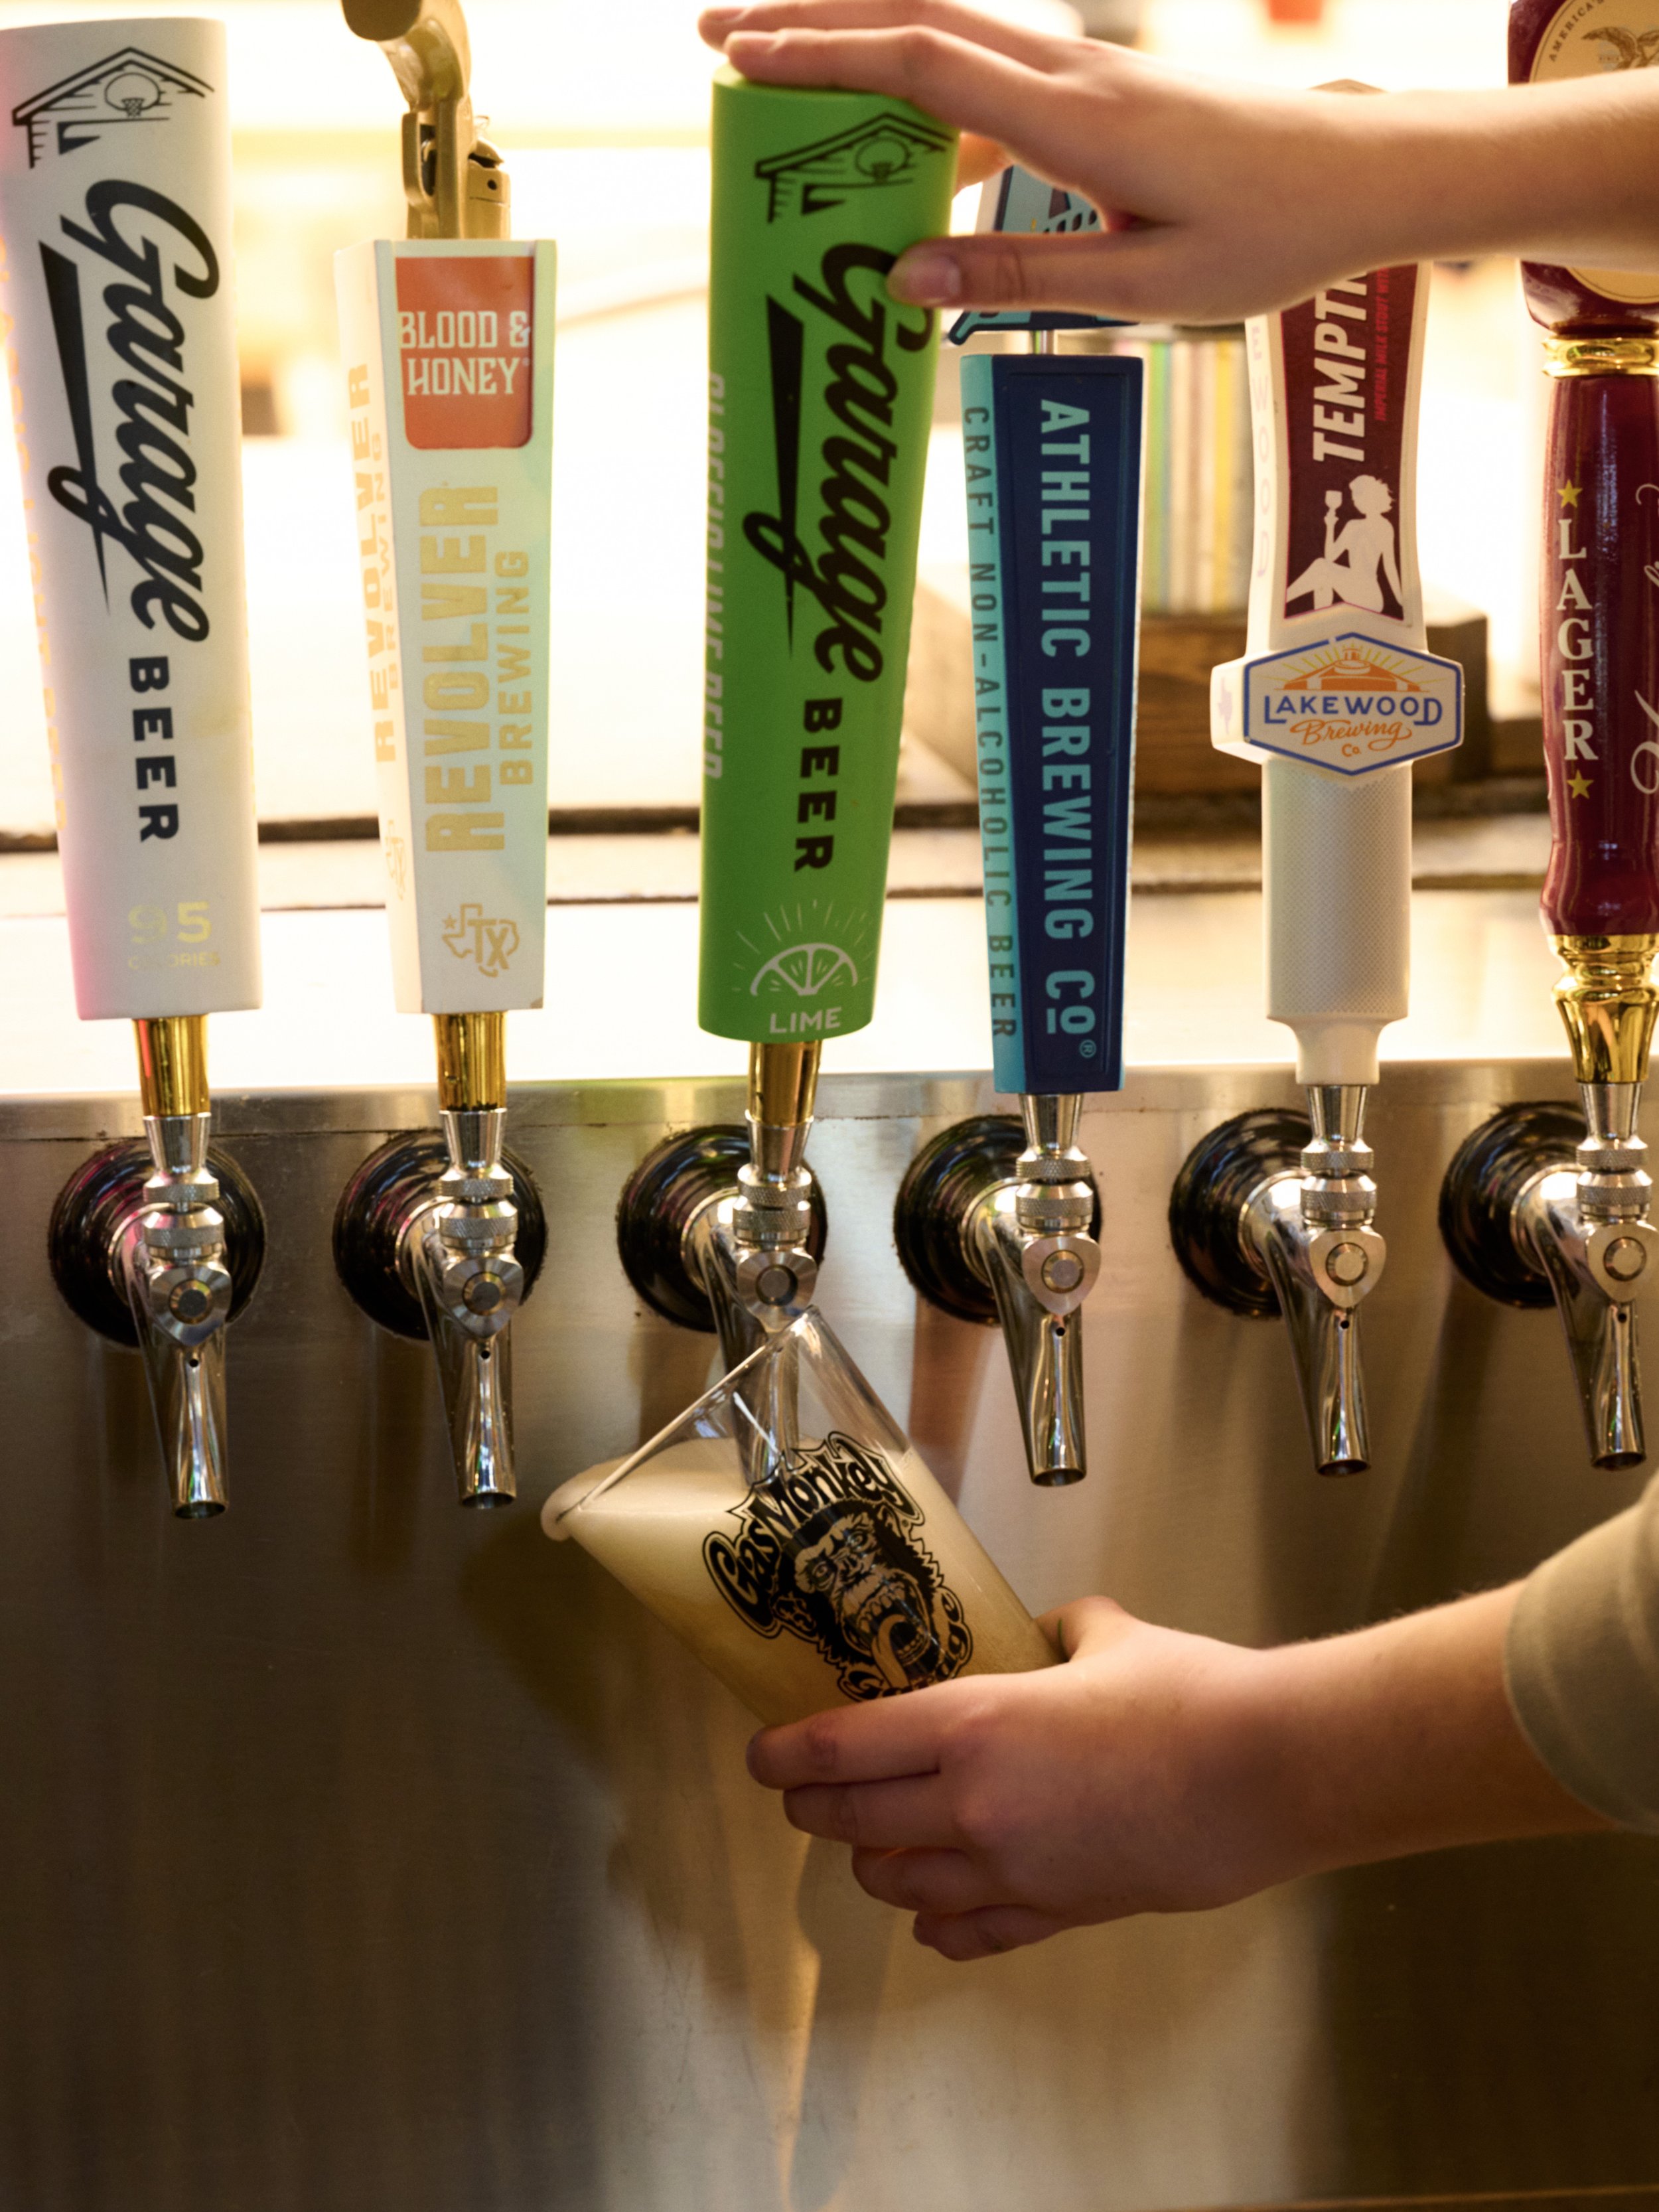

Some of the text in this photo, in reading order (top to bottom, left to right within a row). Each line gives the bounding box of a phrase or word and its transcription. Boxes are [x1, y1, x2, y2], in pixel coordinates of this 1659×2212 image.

[38, 179, 220, 642] Garage
[399, 311, 531, 349] BLOOD &
[407, 358, 521, 396] HONEY
[347, 363, 396, 763] REVOLVER
[372, 433, 397, 690] BREWING
[743, 243, 934, 682] Garage
[1041, 400, 1090, 656] ATHLETIC
[129, 656, 179, 842] BEER
[419, 486, 505, 852] REVOLVER
[494, 551, 534, 785] BREWING
[964, 406, 1017, 1037] CRAFT NON-ALCOHOLIC BEER
[1264, 696, 1443, 726] LAKEWOOD
[1290, 719, 1412, 751] Brewing
[1555, 519, 1599, 761] LAGER
[794, 698, 843, 873] BEER
[1042, 688, 1094, 939] BREWING
[128, 901, 212, 945] 95
[128, 951, 221, 970] CORIES
[770, 1007, 842, 1035] LIME
